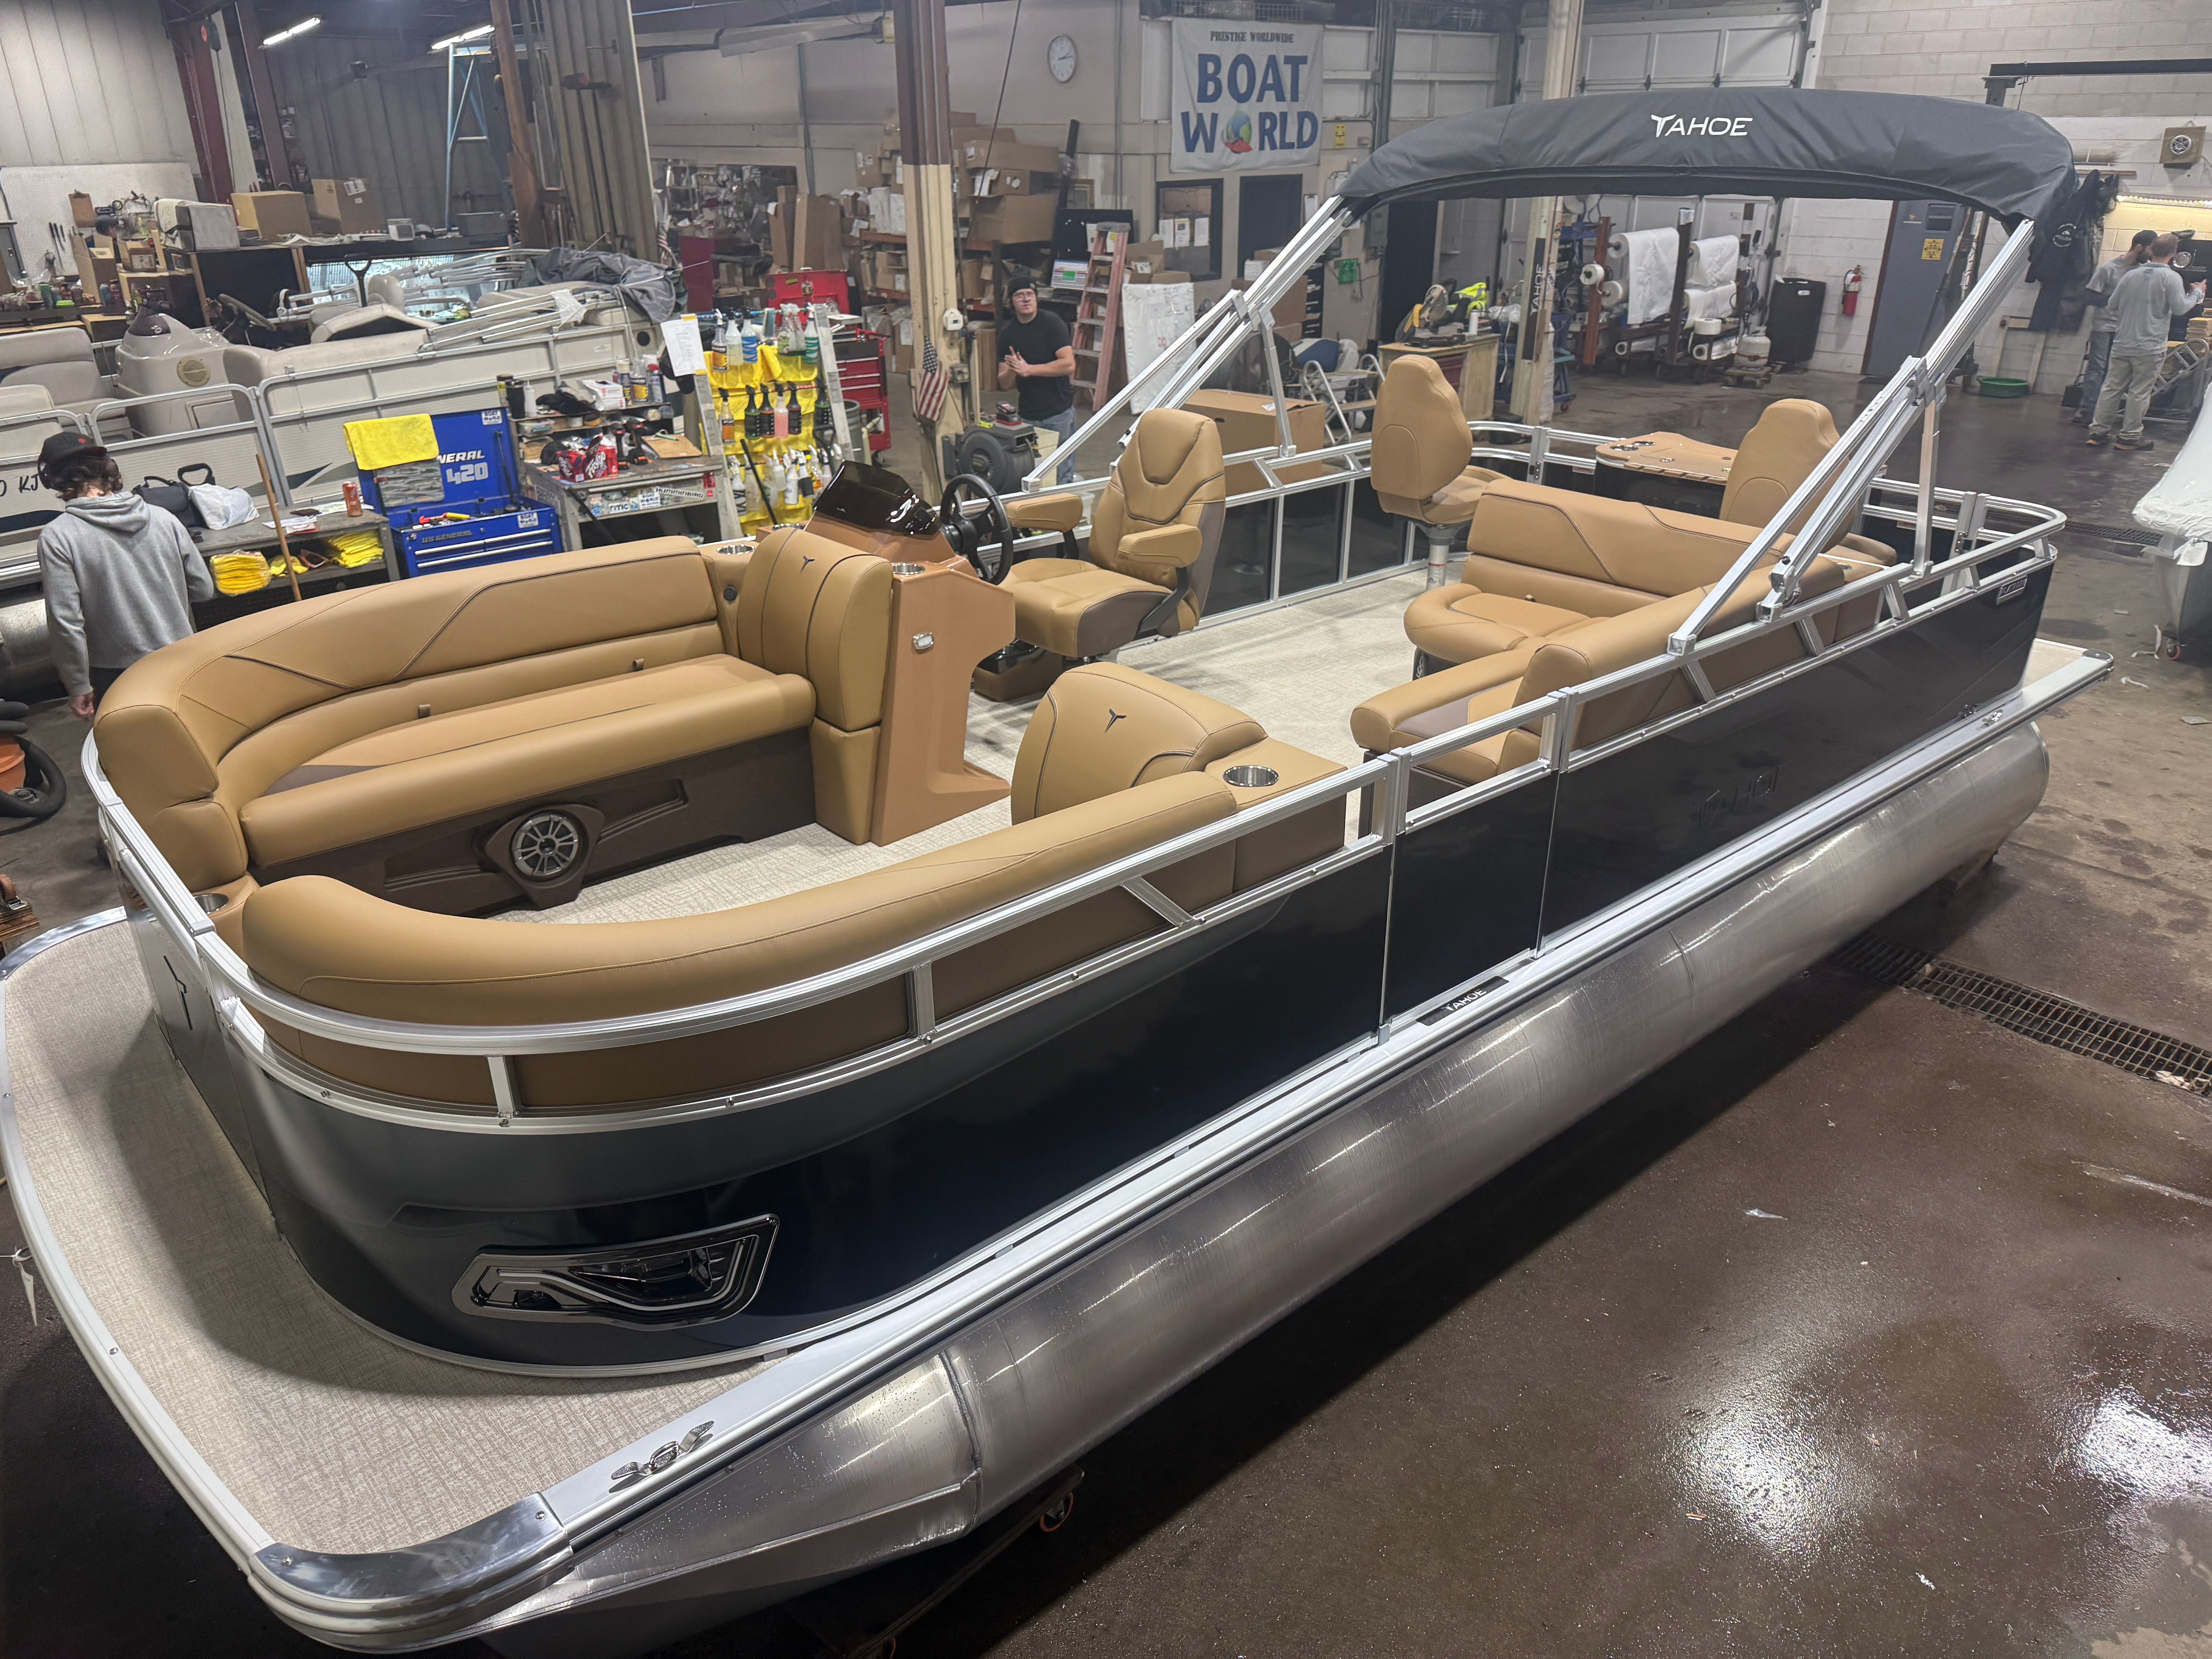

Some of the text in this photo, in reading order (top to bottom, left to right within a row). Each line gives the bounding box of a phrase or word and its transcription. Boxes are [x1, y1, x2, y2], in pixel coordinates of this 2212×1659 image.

[1210, 31, 1294, 43] PRESTIGE WORLDWIDE
[1197, 53, 1308, 103] BOAT
[1651, 114, 1753, 137] TAHOE
[437, 450, 485, 464] NERAL
[446, 462, 488, 484] 420
[1441, 989, 1487, 1011] TAHOE
